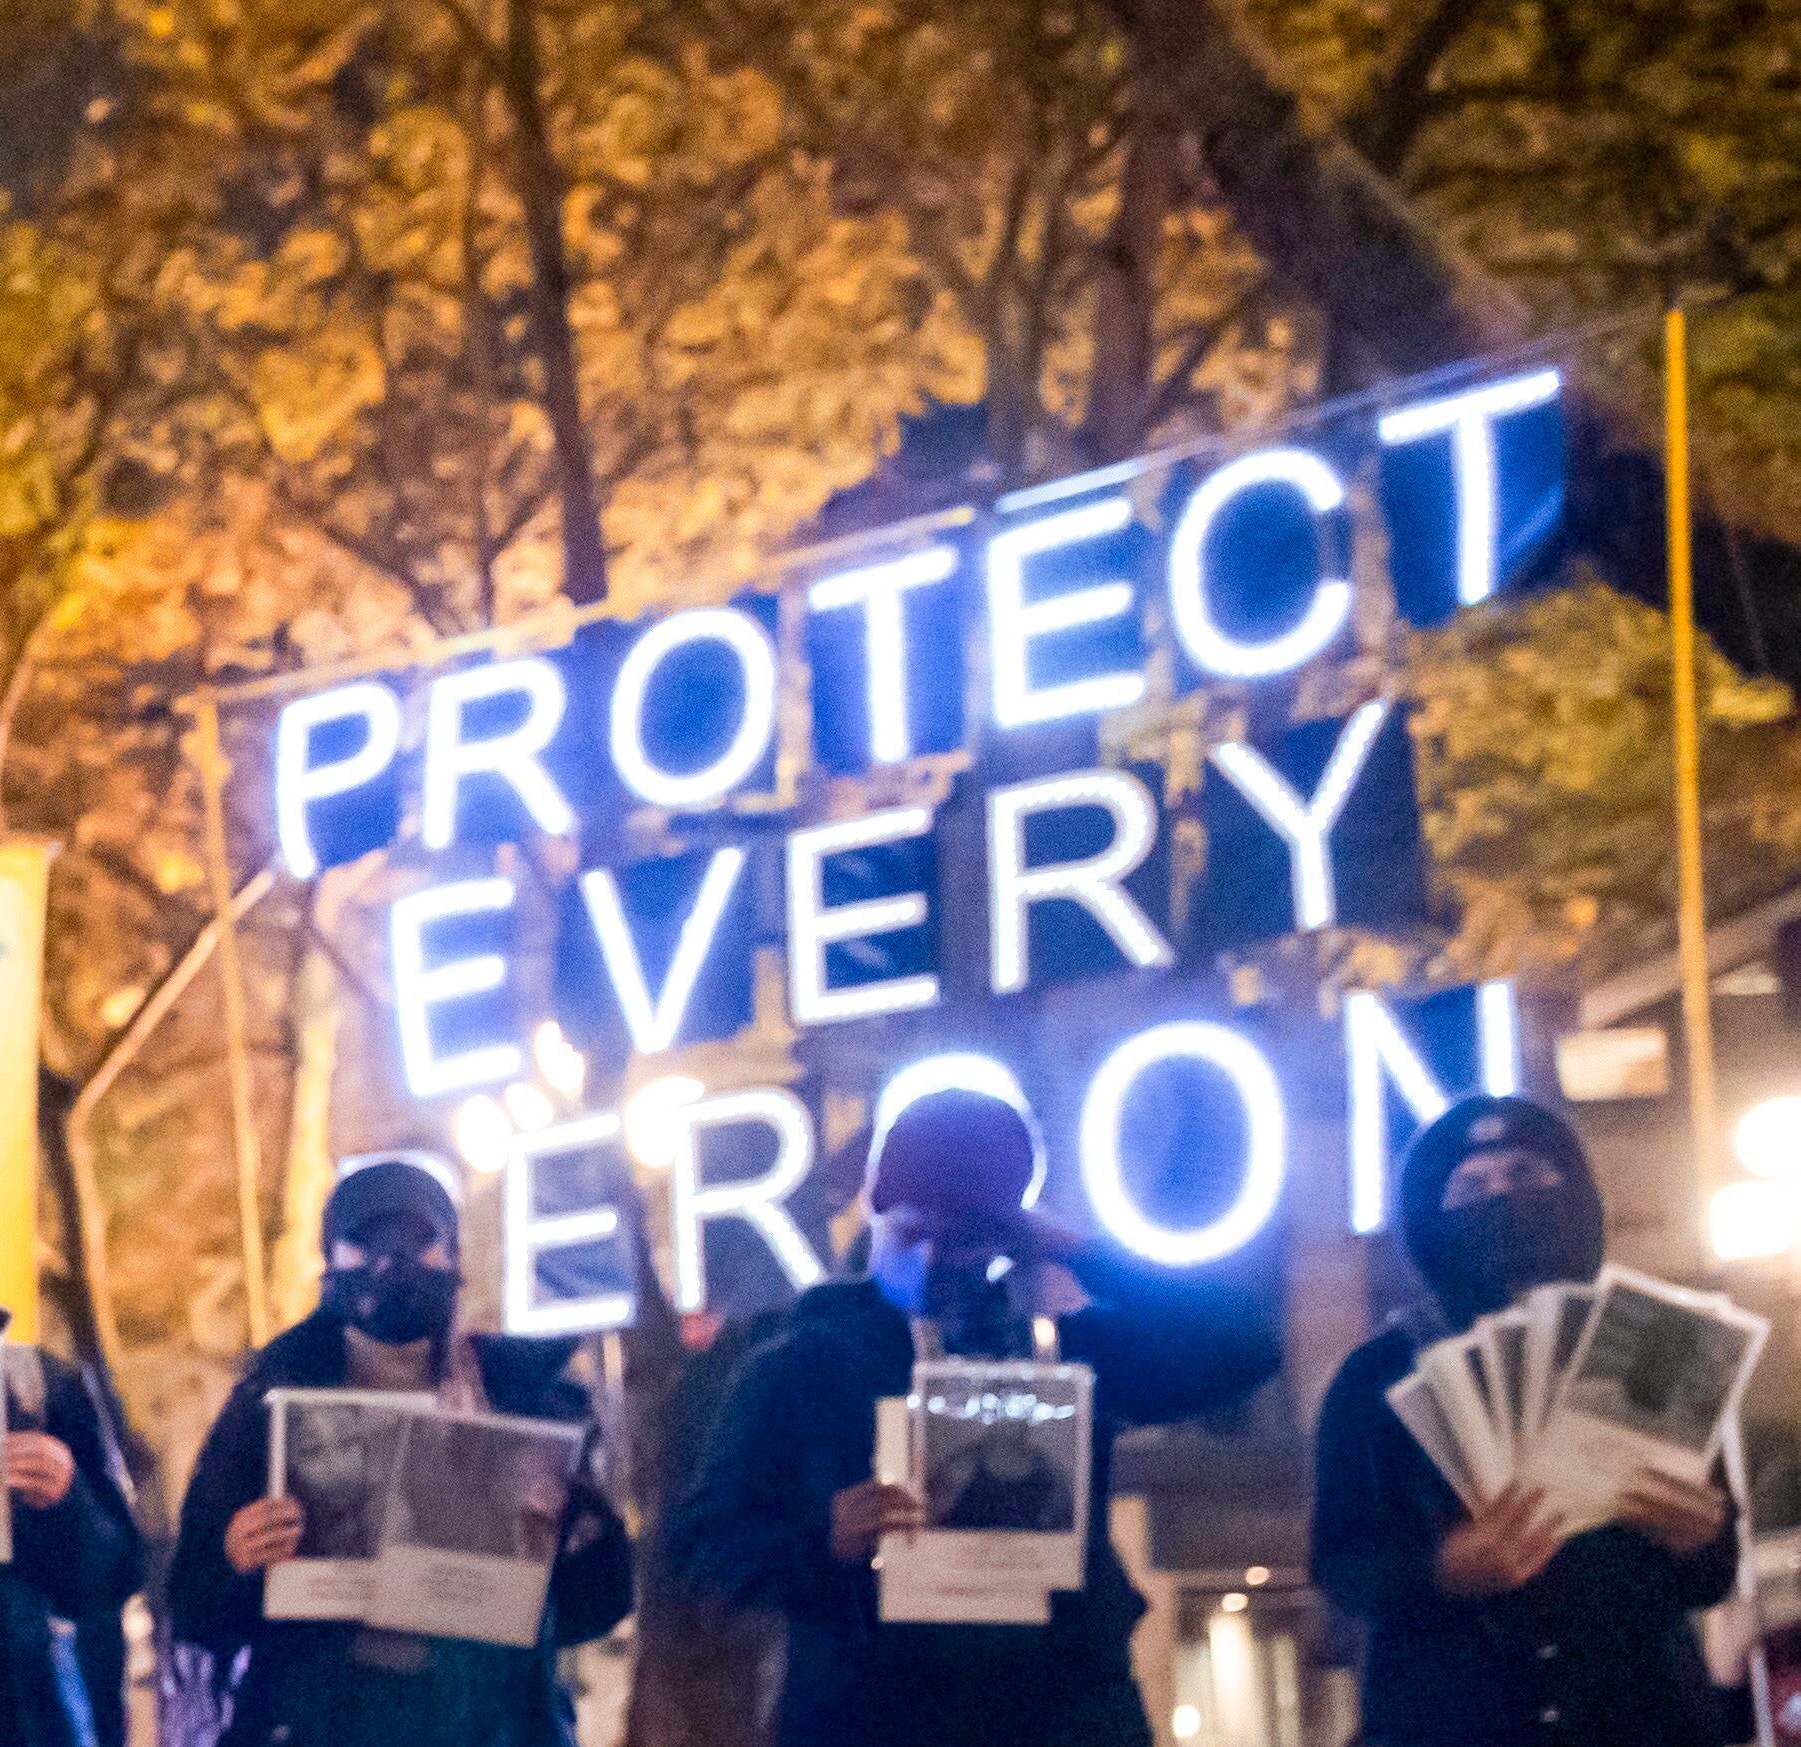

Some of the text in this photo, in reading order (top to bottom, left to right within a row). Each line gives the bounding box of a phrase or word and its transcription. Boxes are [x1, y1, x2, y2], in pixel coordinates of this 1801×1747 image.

[271, 366, 1565, 882] PROTECT
[390, 696, 1388, 1100] EVERY
[333, 976, 1522, 1338] ERON
